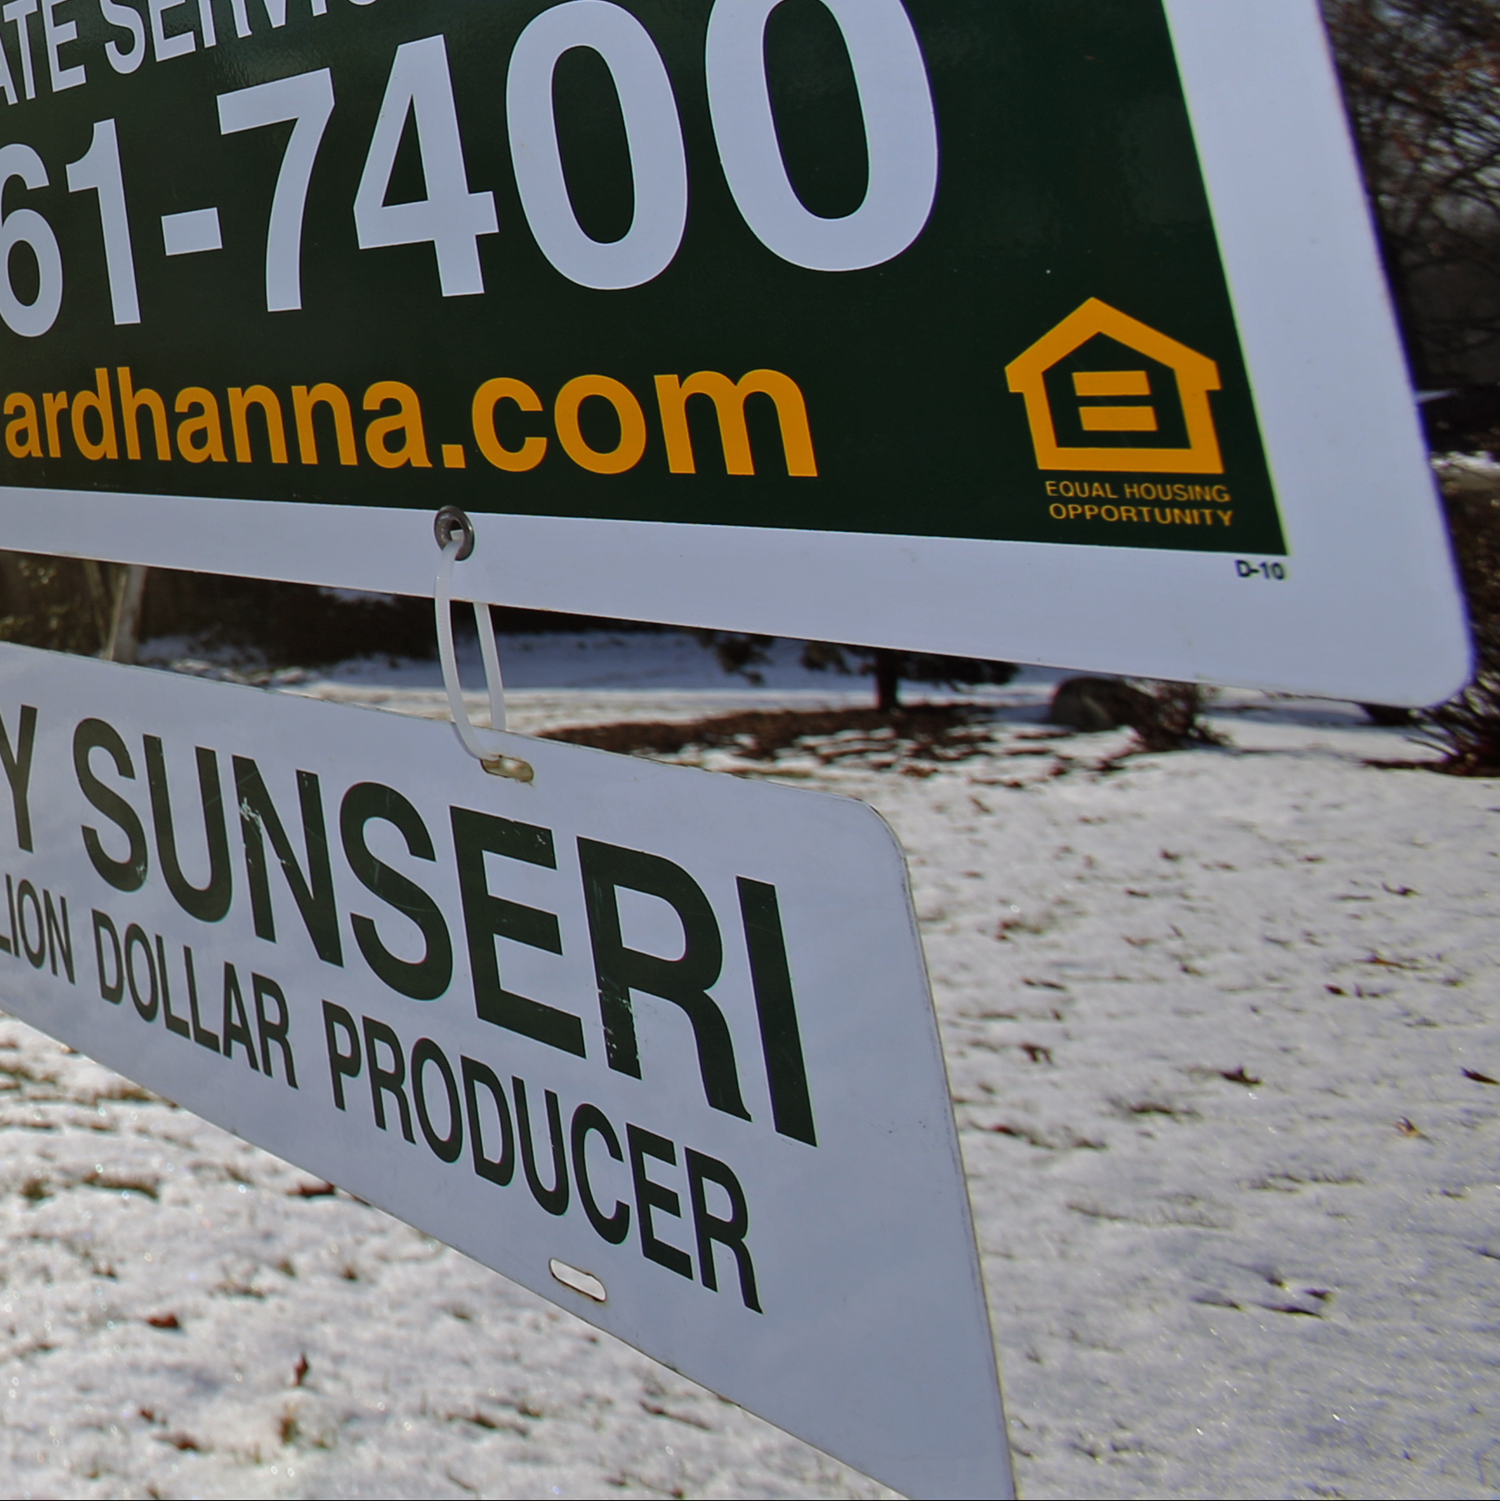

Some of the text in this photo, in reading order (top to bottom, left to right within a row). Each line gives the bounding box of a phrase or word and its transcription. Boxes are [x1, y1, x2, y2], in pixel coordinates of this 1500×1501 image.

[1045, 480, 1231, 503] EQUAL HOUSING
[1049, 503, 1234, 527] OPPORTUNITY
[1234, 559, 1286, 581] D-10
[72, 717, 818, 1148] SUNSERI
[91, 908, 299, 1090] DOLLAR
[321, 999, 764, 1315] PRODUCER
